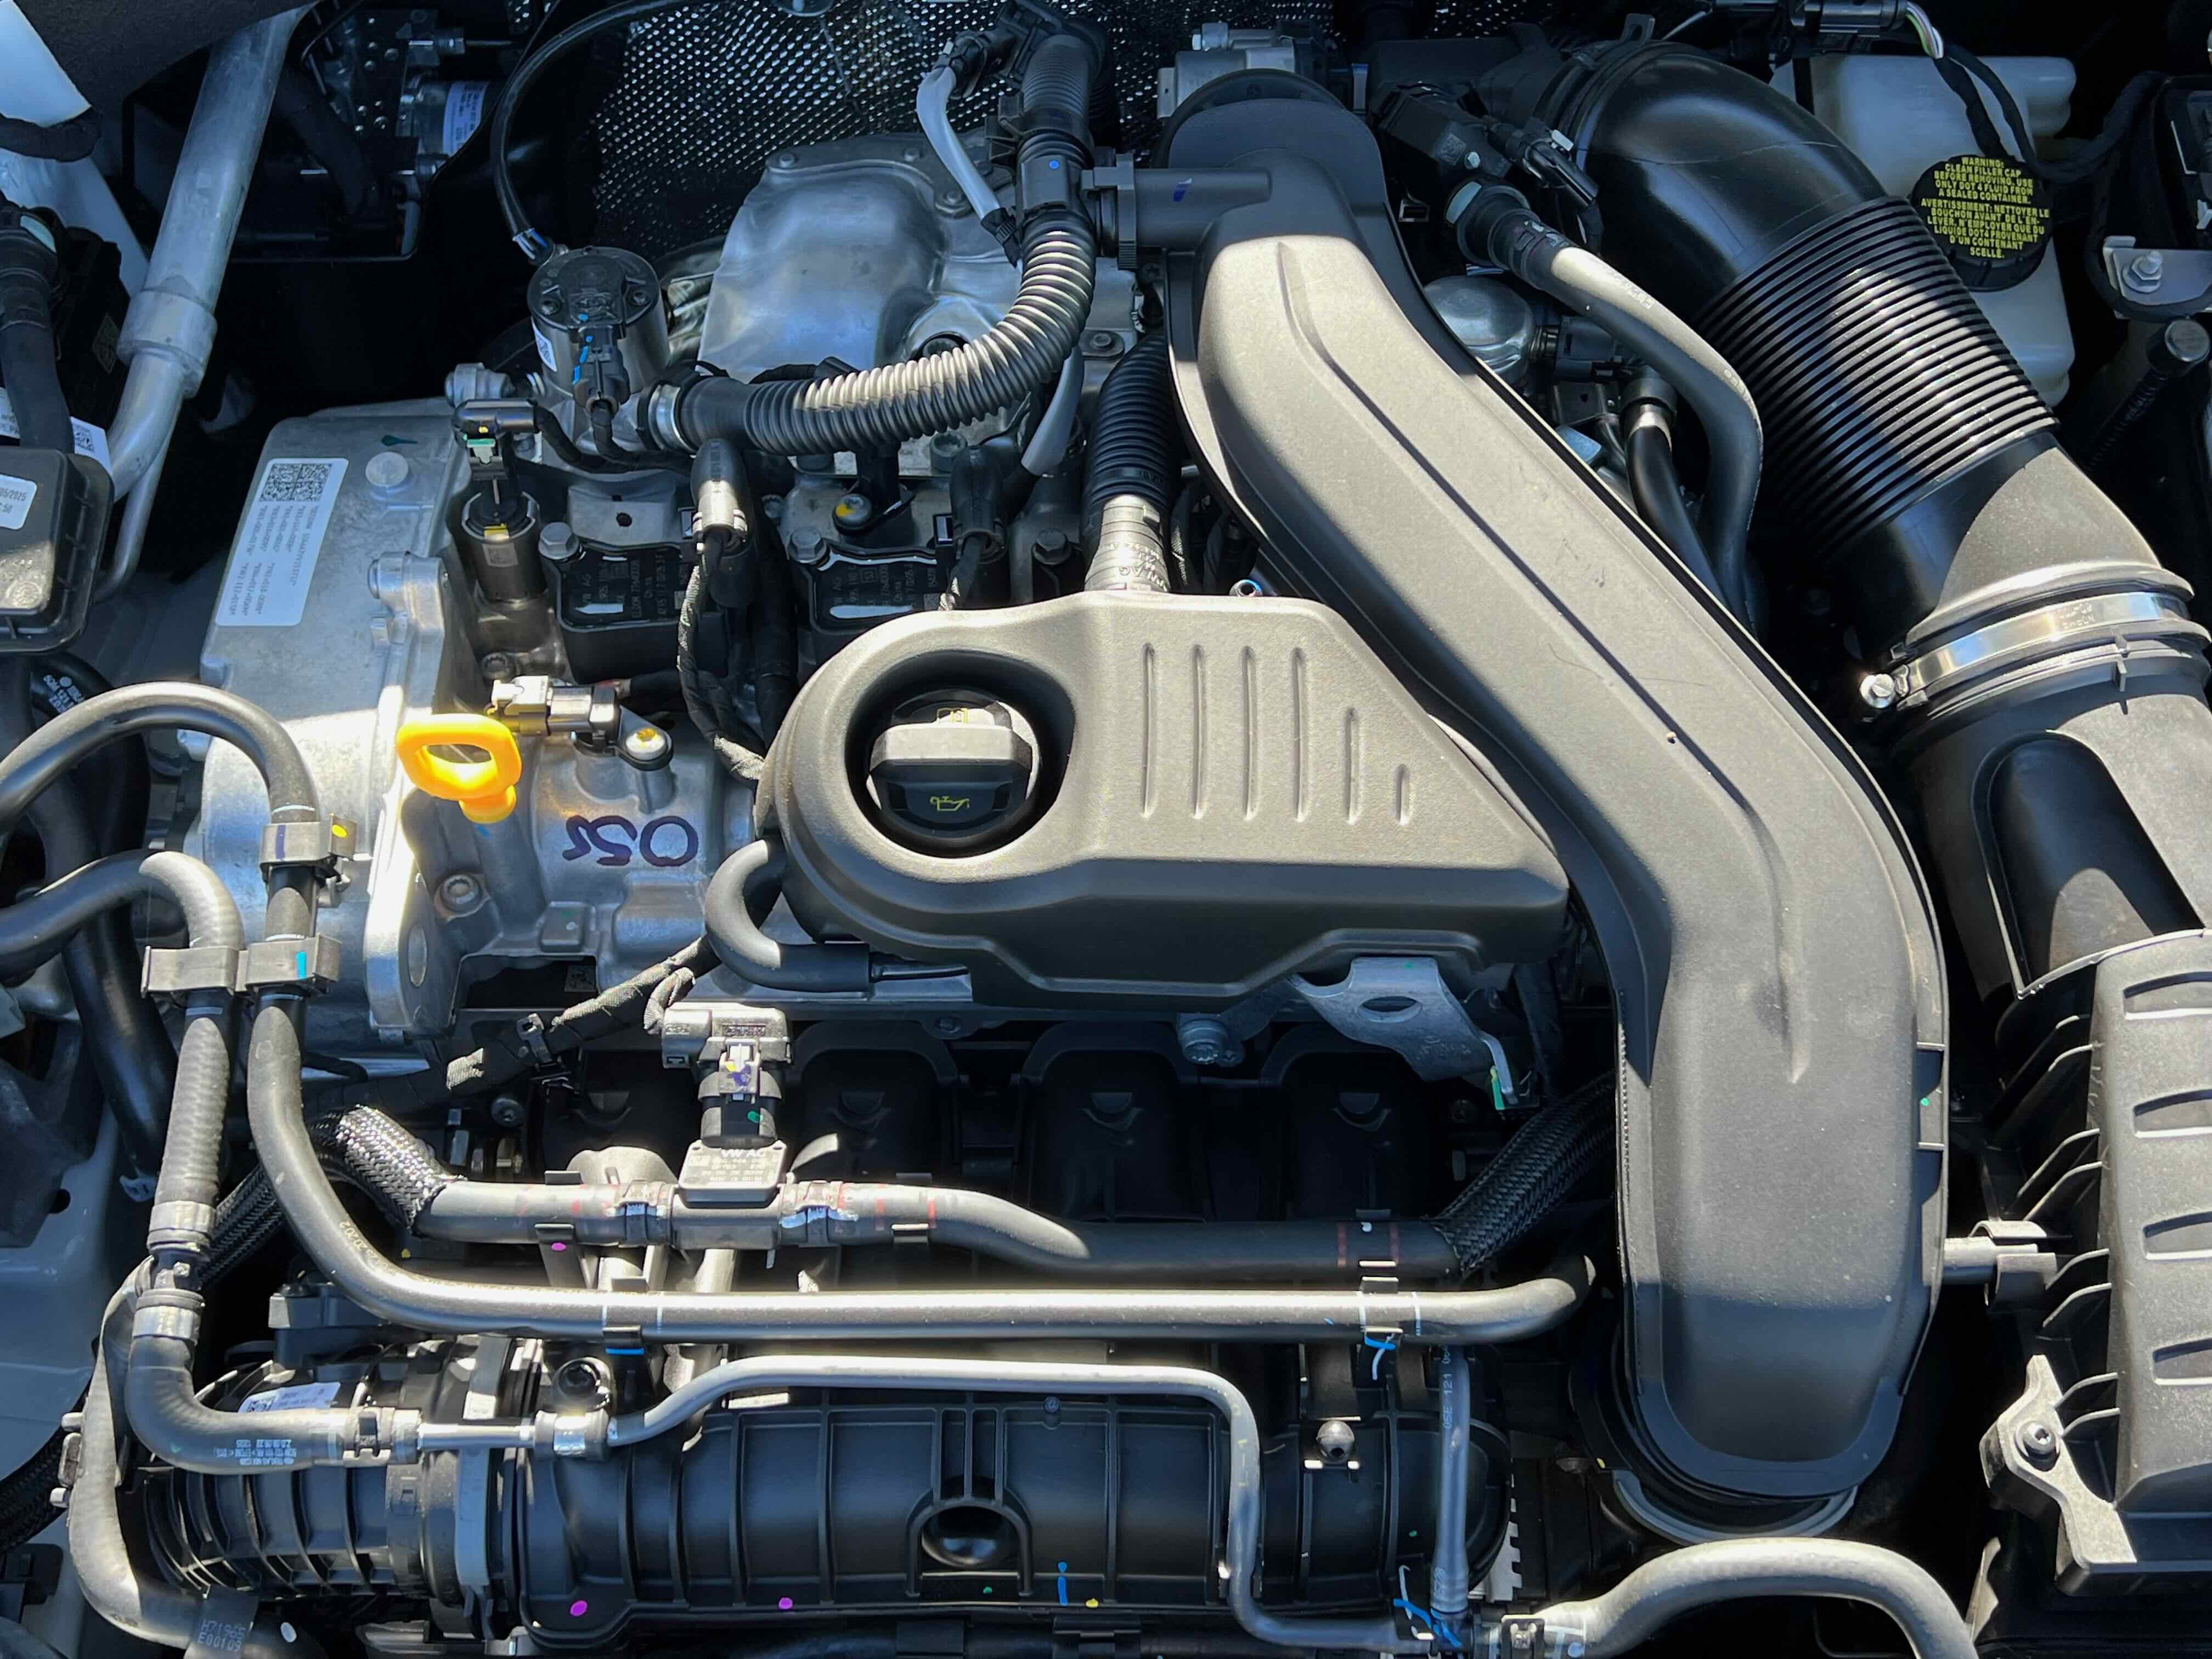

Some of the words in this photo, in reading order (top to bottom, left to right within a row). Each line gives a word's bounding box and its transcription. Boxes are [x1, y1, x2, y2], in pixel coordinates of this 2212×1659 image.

[1961, 156, 2004, 168] WARNING:
[1945, 163, 1973, 174] CLEAN
[1974, 166, 2002, 177] FILLER
[2004, 168, 2022, 178] CAP
[1934, 171, 1967, 182] BEFORE
[2016, 178, 2033, 188] USE
[1935, 179, 1957, 189] ONLY
[1959, 182, 1976, 191] DOT
[1977, 183, 1983, 191] 4
[1984, 183, 2008, 194] FLUID
[2010, 186, 2033, 196] FROM
[1938, 188, 1945, 197] A
[1946, 189, 1978, 200] SEALED
[1979, 191, 2031, 204] CONTAINER.
[1921, 198, 1993, 212] AVERTISSEMENT:
[1994, 205, 2038, 218] NETTOYER
[2039, 208, 2050, 218] LE
[1931, 207, 1973, 219] BOUCHON
[1974, 211, 2001, 222] AVANT
[1927, 216, 1957, 227] LEVER.
[2013, 223, 2031, 234] QUE
[2033, 225, 2045, 235] DU
[1934, 225, 1967, 236] LIQUIDE
[1990, 229, 2038, 243] PROVENANT
[1972, 236, 2023, 250] CONTENANT
